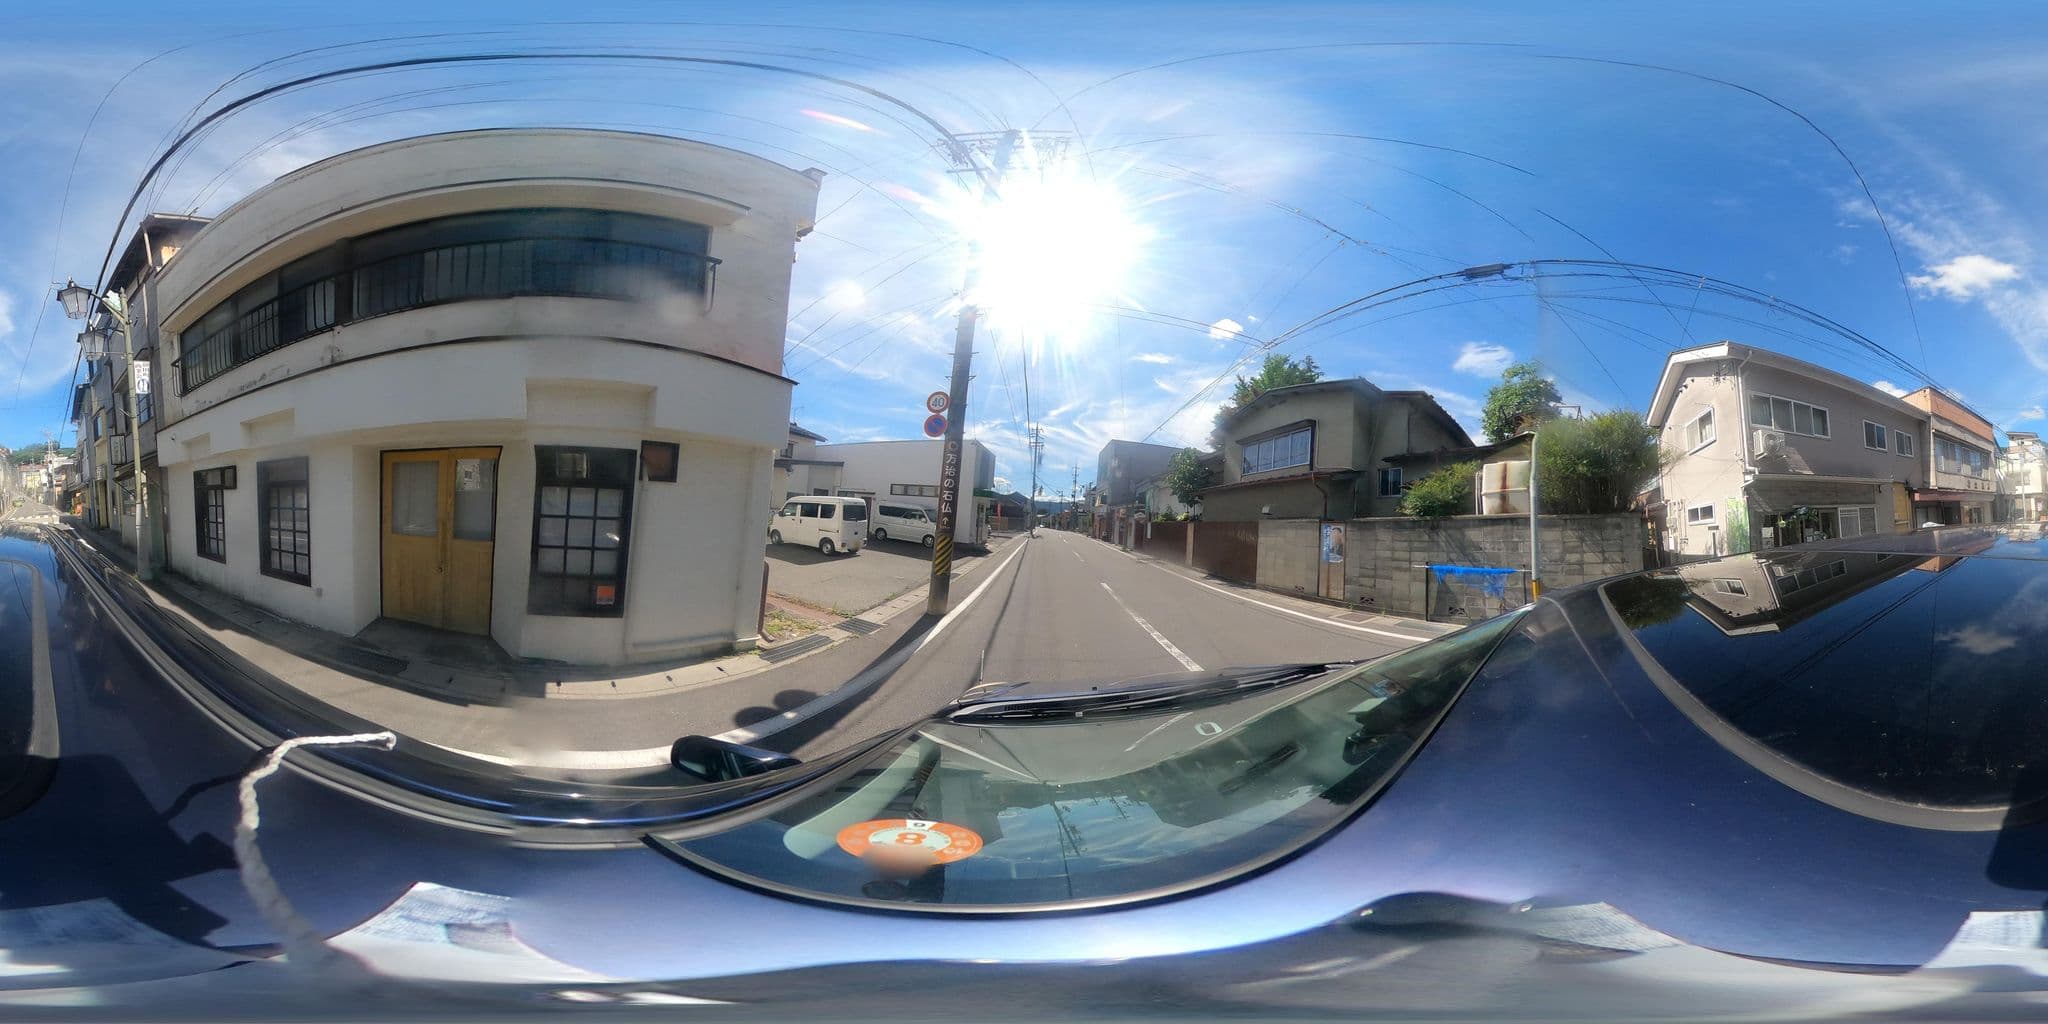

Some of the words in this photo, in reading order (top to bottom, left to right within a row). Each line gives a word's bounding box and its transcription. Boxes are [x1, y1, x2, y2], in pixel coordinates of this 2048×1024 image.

[931, 397, 945, 407] 40
[941, 453, 957, 513] 万治の石仏
[895, 832, 927, 846] 8
